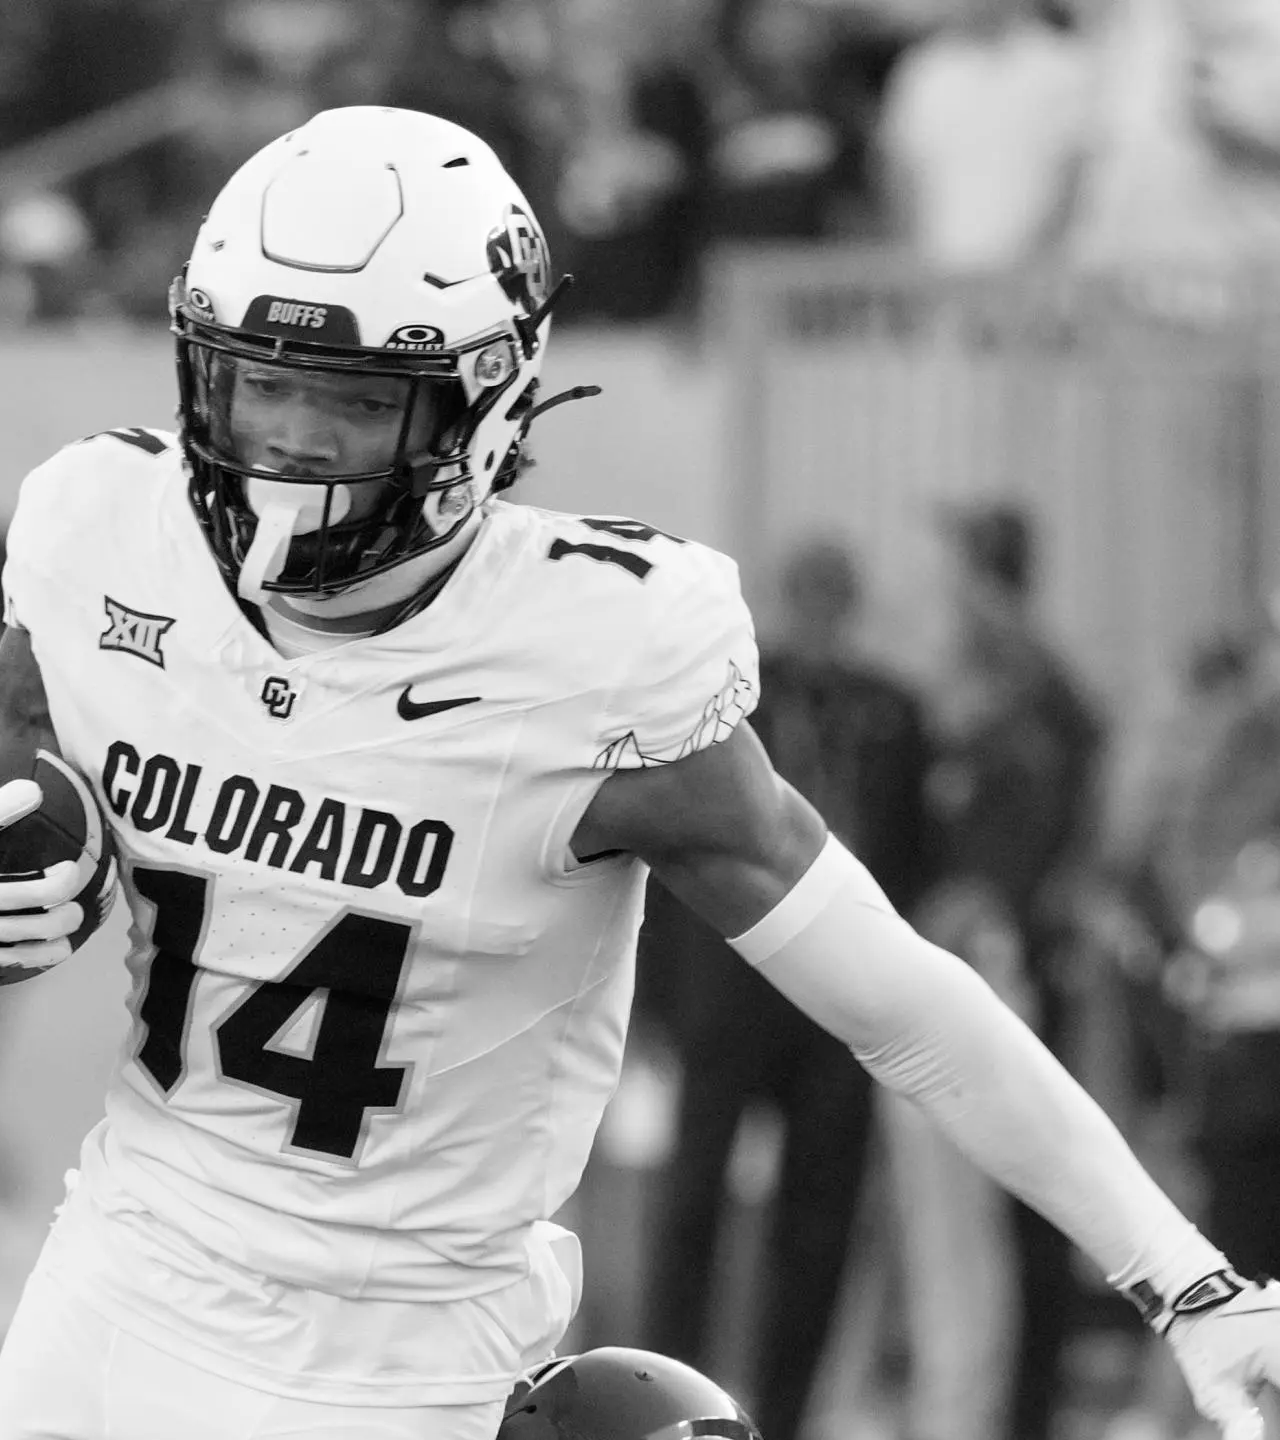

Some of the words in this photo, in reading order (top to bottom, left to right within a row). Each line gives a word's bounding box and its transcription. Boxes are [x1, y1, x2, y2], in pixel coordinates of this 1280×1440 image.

[267, 300, 328, 329] BUFFS
[261, 676, 297, 719] CU
[102, 739, 456, 899] COLORADO
[125, 861, 417, 1168] 14
